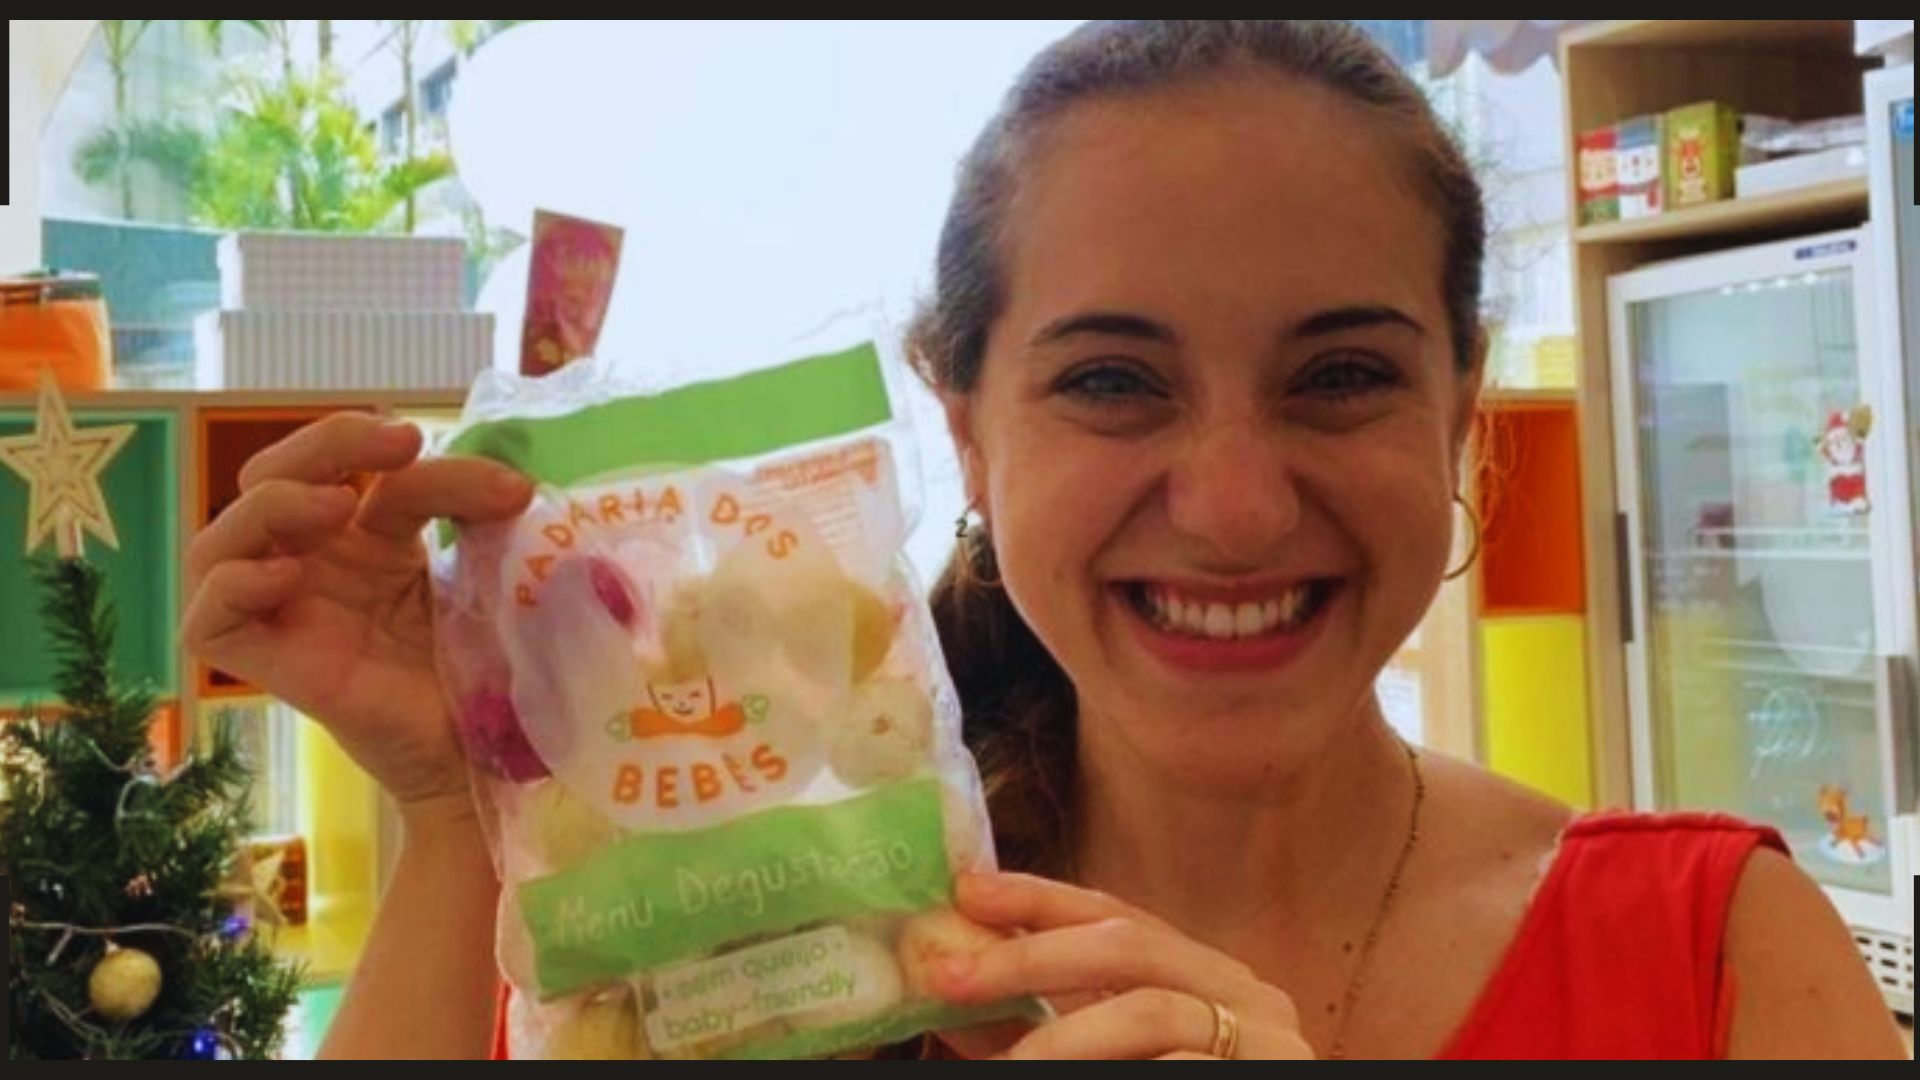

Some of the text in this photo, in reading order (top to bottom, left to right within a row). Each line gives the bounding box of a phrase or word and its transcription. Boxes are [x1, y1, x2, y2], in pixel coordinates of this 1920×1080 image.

[515, 486, 681, 608] PADARIA
[710, 492, 798, 560] DOS
[555, 893, 653, 947] Menu
